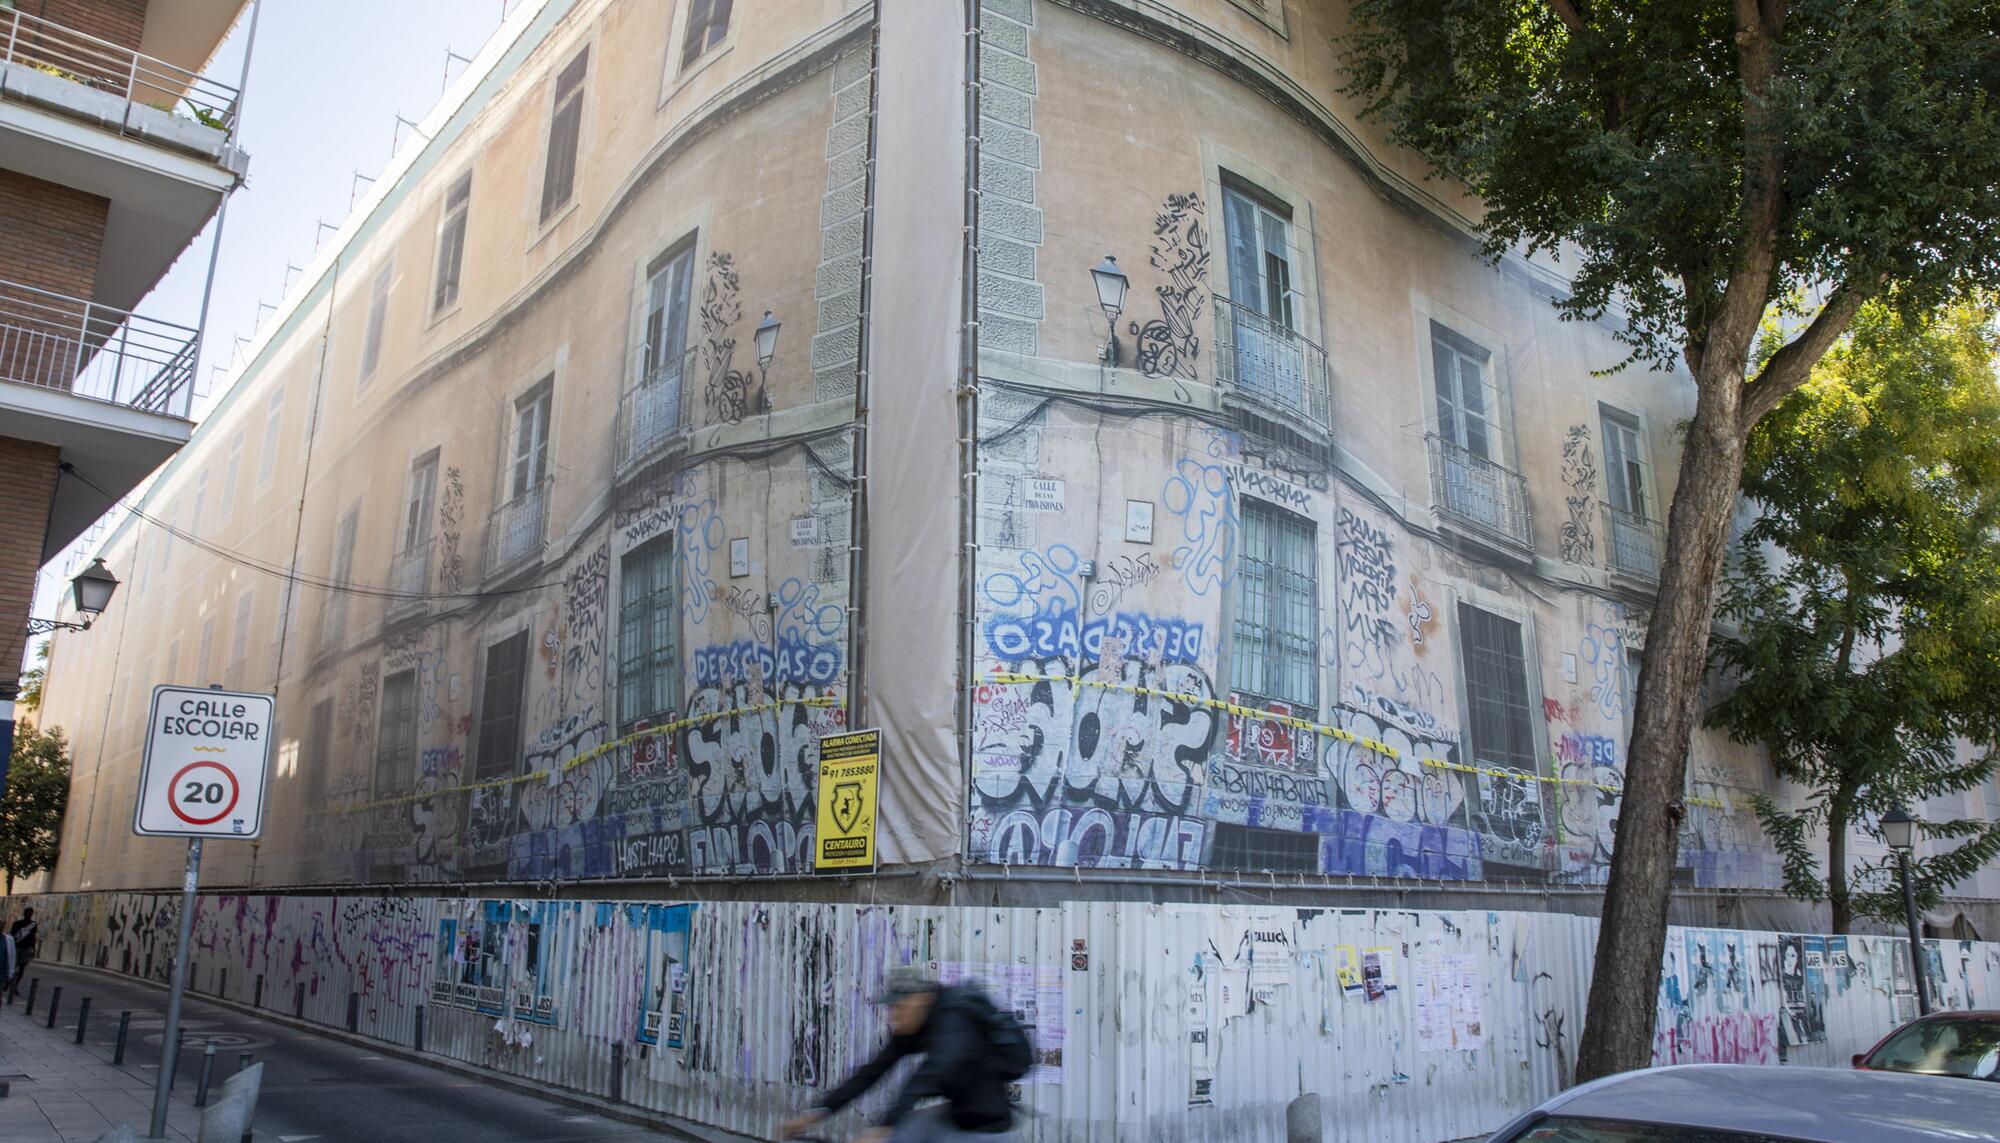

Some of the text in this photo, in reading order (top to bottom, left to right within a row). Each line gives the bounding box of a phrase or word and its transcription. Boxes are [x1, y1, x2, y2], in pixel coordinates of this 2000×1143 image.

[1033, 481, 1056, 491] CALLE
[163, 717, 260, 741] ESCOLAR
[822, 732, 878, 748] ALARMA CONECTADA
[183, 782, 224, 804] 20
[825, 838, 866, 851] CENTAURO
